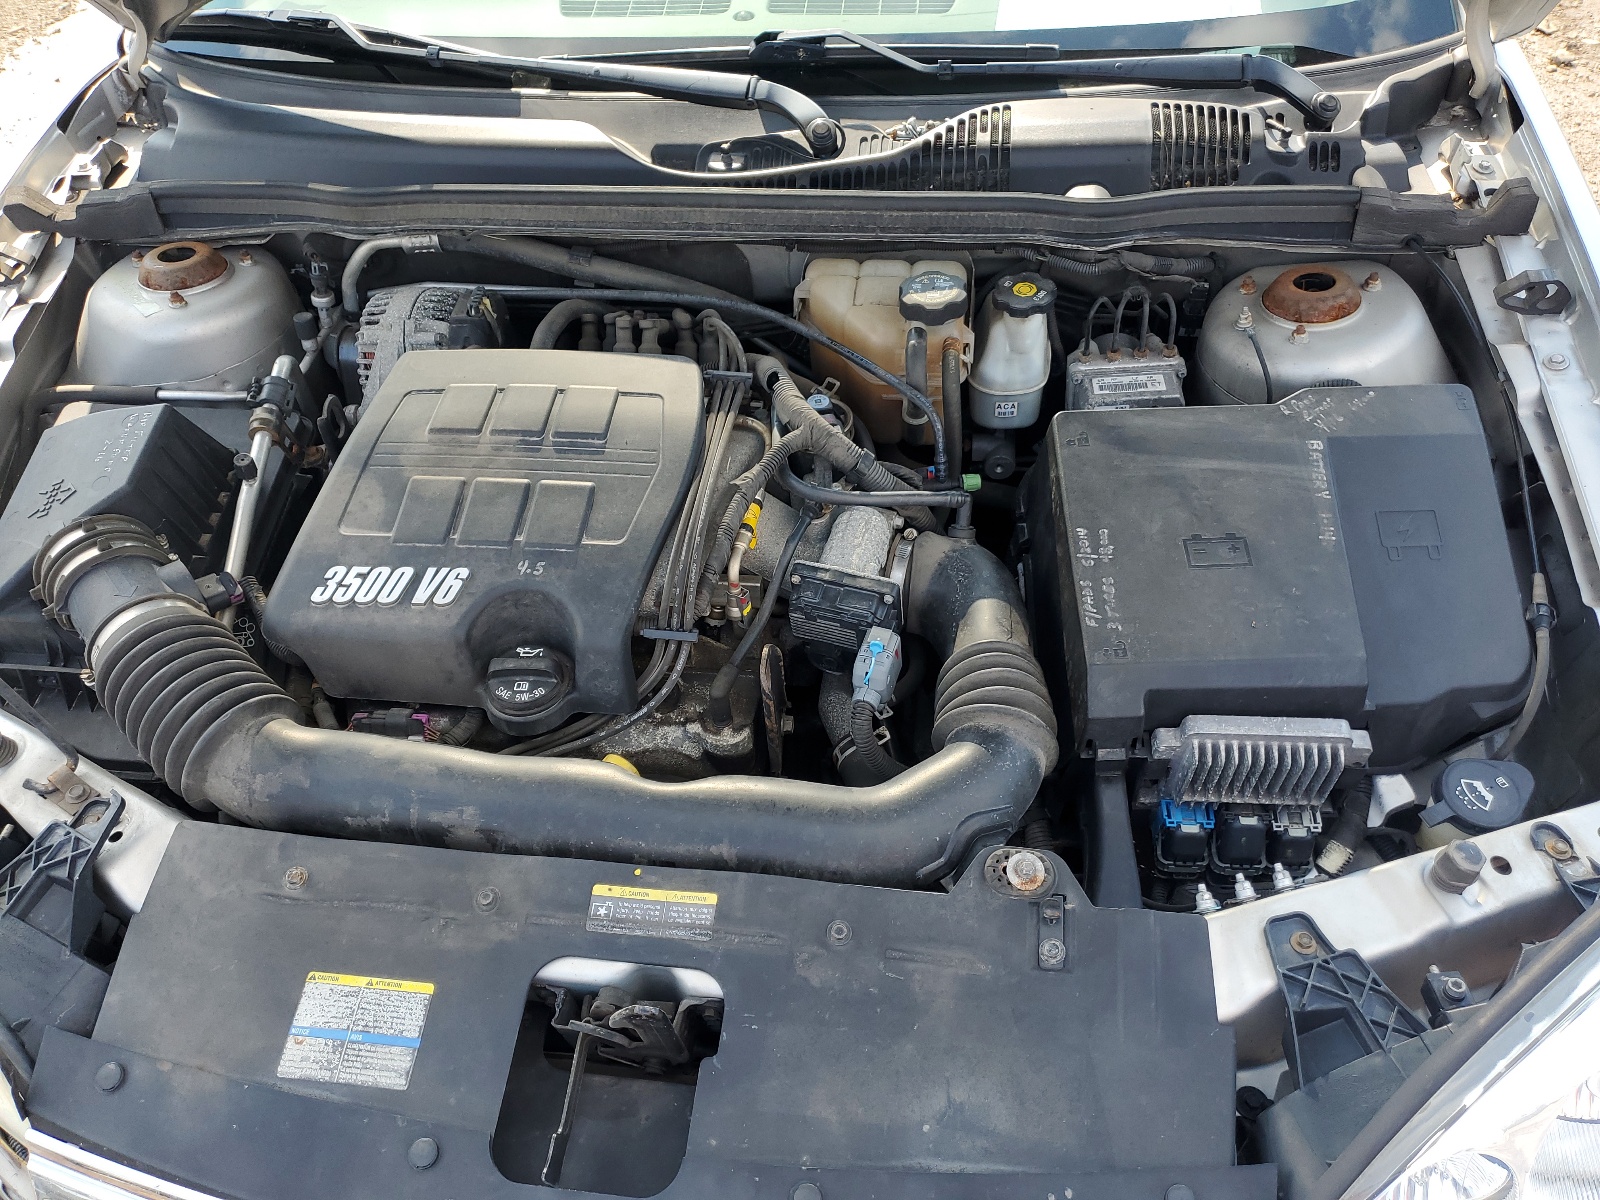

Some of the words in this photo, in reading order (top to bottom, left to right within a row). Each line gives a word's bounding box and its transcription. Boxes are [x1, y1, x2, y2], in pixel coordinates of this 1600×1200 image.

[996, 403, 1016, 411] ACA
[1306, 440, 1332, 499] BATTERY
[517, 560, 546, 576] 4.5
[310, 565, 415, 607] 3500
[411, 566, 470, 608] V6
[495, 686, 512, 700] SAE
[515, 687, 545, 702] 5W-30
[628, 890, 650, 898] CAUTION
[679, 895, 707, 903] ATTENTION
[316, 974, 340, 982] CAUTION
[374, 980, 403, 989] ATTENTION
[290, 1027, 310, 1035] NOTICE
[350, 1033, 363, 1041] AVIS
